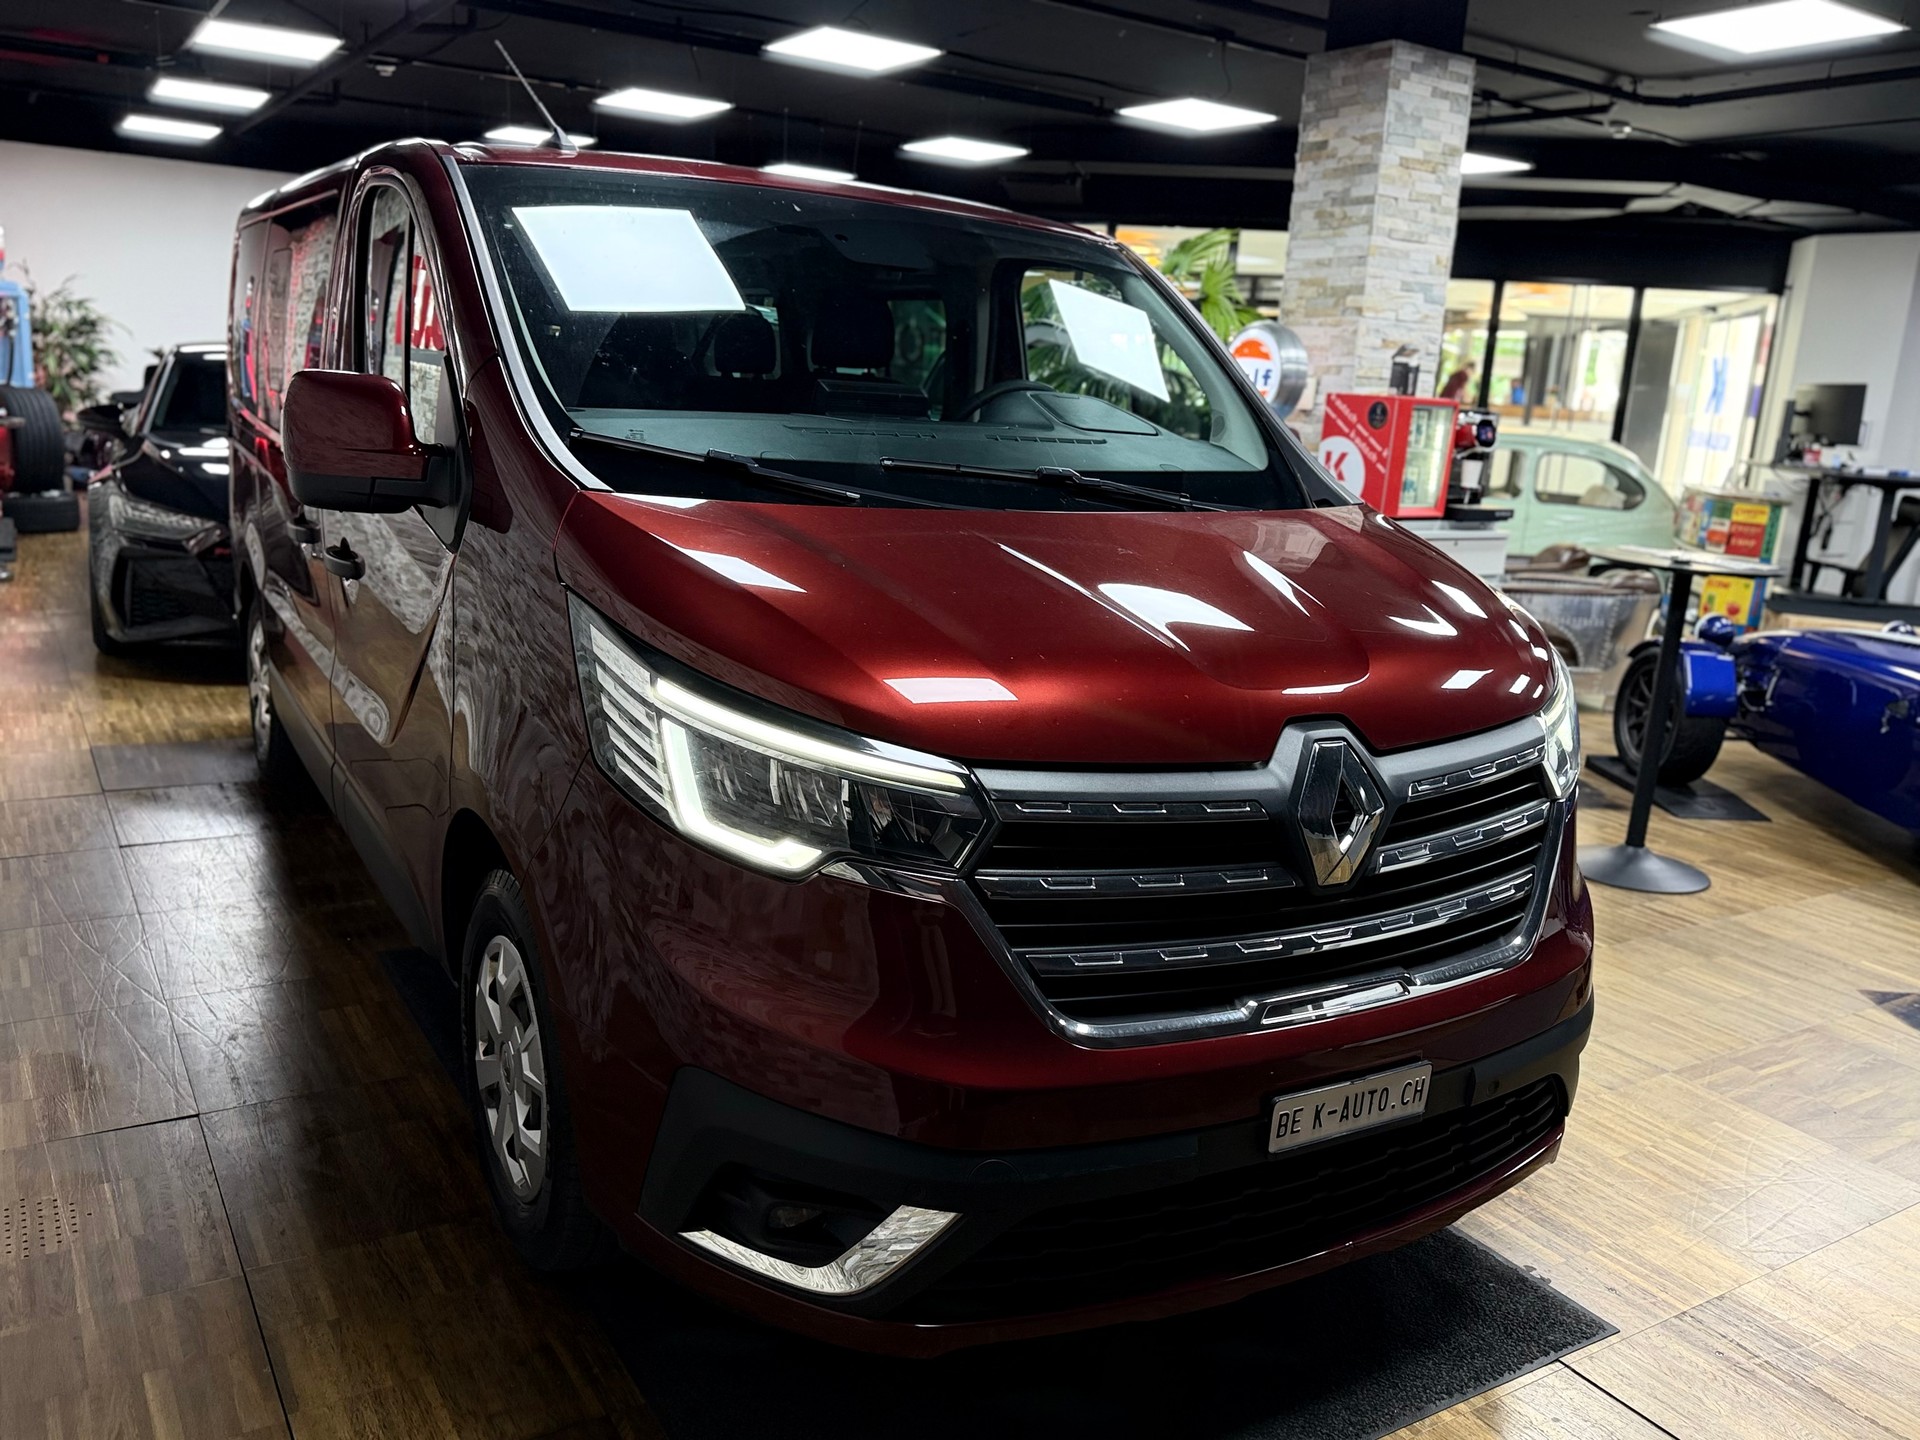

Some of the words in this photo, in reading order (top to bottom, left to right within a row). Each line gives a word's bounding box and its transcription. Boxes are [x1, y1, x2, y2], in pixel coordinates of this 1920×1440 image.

[1325, 451, 1349, 481] K
[1276, 1107, 1304, 1139] BE
[1312, 1077, 1426, 1130] K-AUTO.CH
